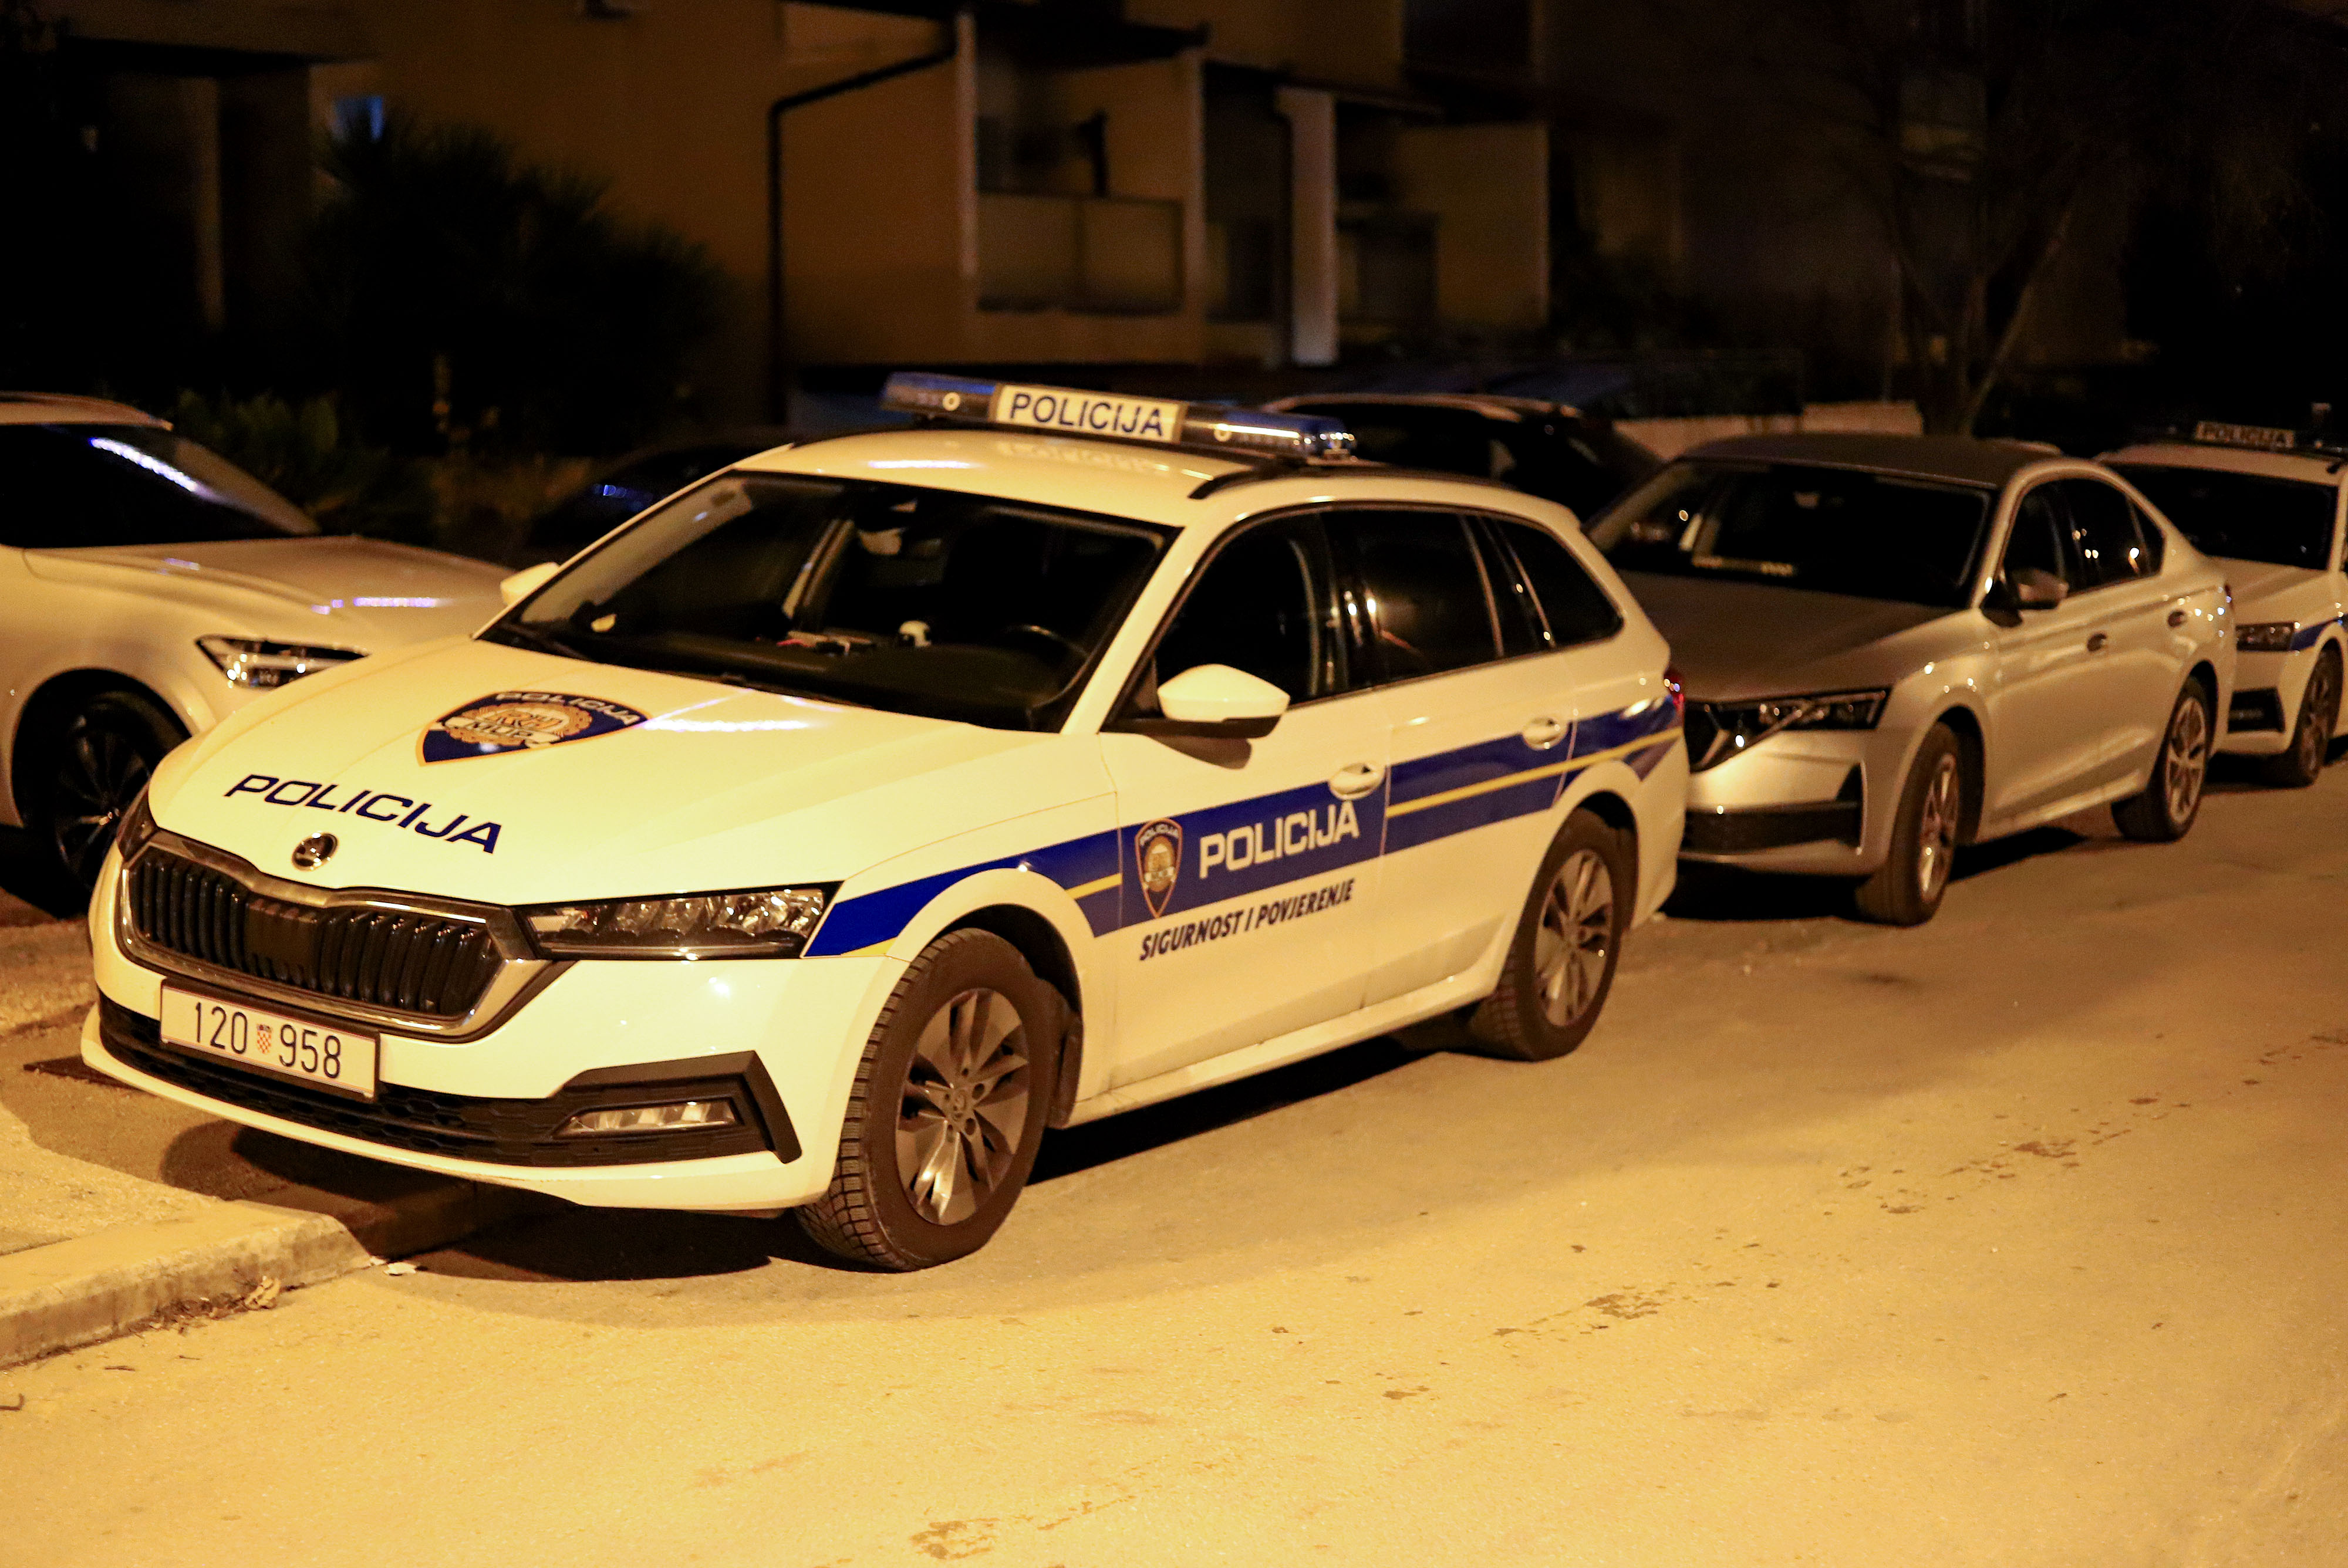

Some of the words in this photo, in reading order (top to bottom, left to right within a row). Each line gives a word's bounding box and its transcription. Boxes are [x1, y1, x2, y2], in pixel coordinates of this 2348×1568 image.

[1010, 393, 1164, 437] POLICIJA
[494, 691, 640, 725] POLICIJA
[223, 774, 502, 854] POLICIJA
[1199, 799, 1360, 880] POLICIJA
[1139, 913, 1241, 961] SIGURNOST
[1244, 913, 1254, 931] I
[1256, 878, 1355, 928] POVJERENJE
[195, 1002, 248, 1055] 120
[278, 1024, 342, 1079] 958
